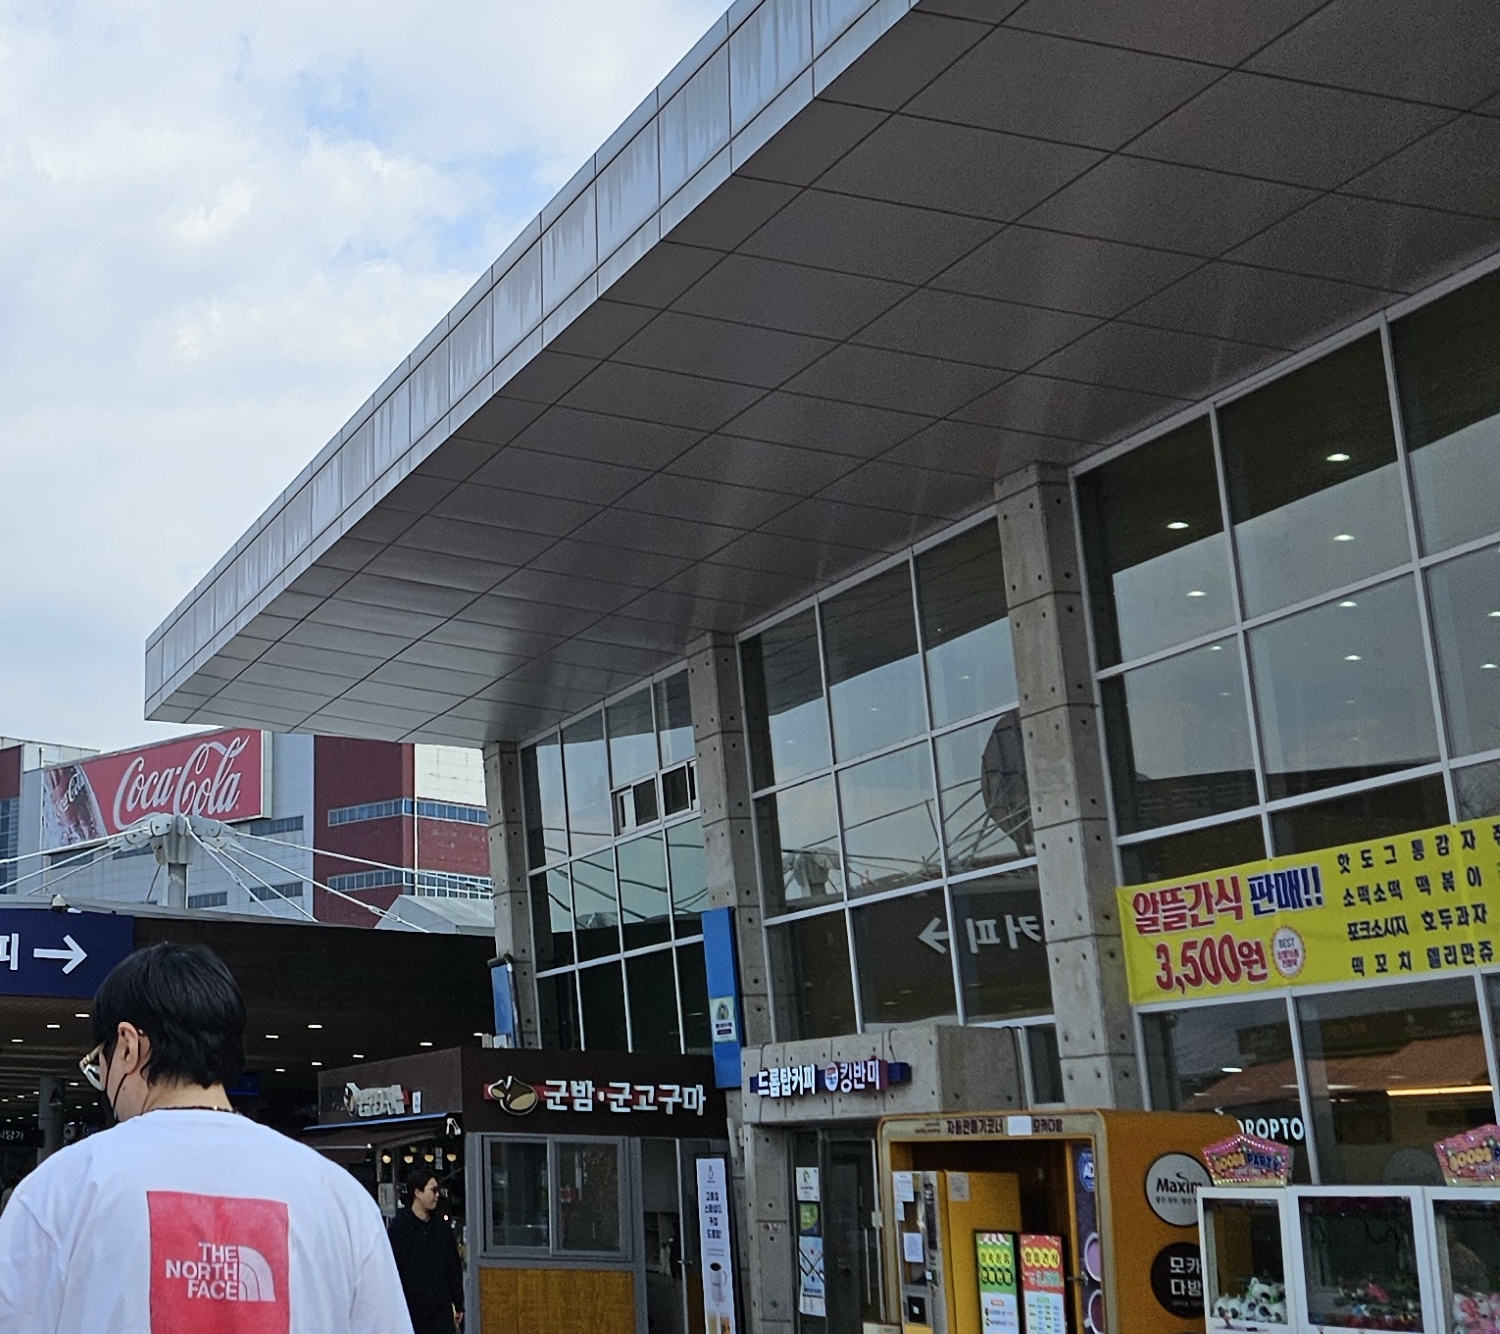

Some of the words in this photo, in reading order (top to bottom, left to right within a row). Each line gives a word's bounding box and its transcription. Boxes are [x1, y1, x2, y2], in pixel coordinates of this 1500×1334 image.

[113, 735, 250, 831] Coca-Cola
[1132, 875, 1244, 935] 알뜰간식
[1247, 865, 1324, 916] 판매!!
[1343, 879, 1404, 907] 소떡소떡
[1347, 915, 1410, 941] 포크소시지
[1421, 902, 1487, 931] 호두과자
[1155, 934, 1268, 995] 3,500원
[757, 1063, 816, 1098] 드롭탑커피
[839, 1059, 881, 1094] 킹반미
[199, 1242, 238, 1263] THE
[1170, 1257, 1202, 1275] 모카
[165, 1259, 238, 1281] NORTH
[188, 1279, 238, 1301] FACE
[1171, 1279, 1202, 1296] 다방
